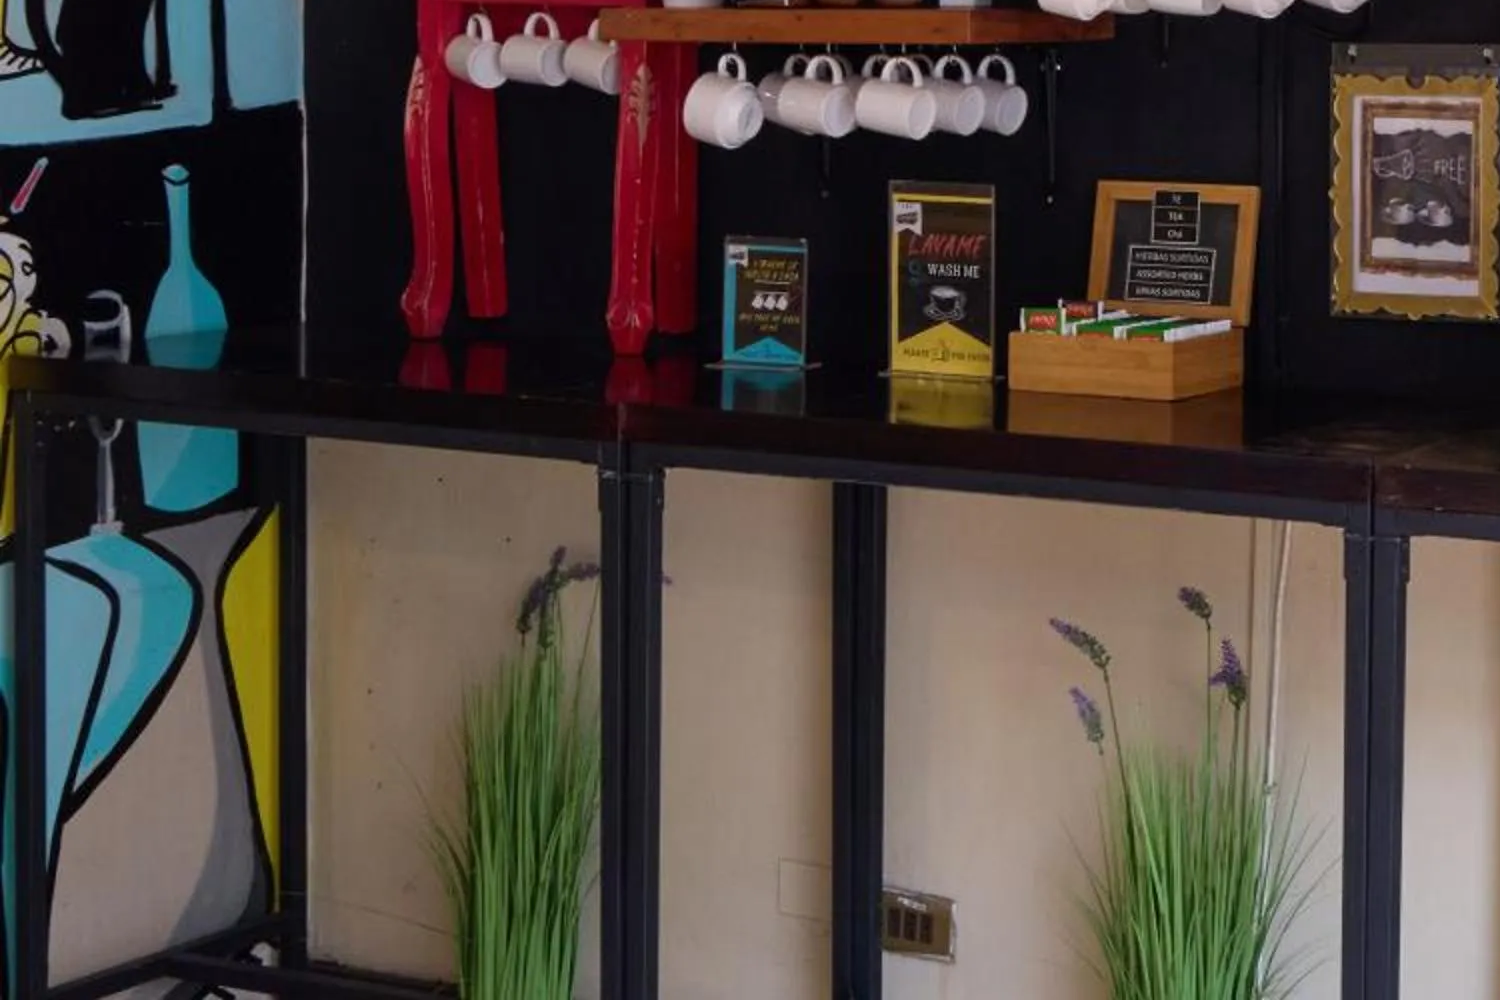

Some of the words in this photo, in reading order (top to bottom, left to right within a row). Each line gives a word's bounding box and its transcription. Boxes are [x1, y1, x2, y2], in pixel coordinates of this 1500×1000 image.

[1433, 154, 1466, 186] FREE
[927, 262, 961, 278] WASH
[963, 264, 981, 279] ME
